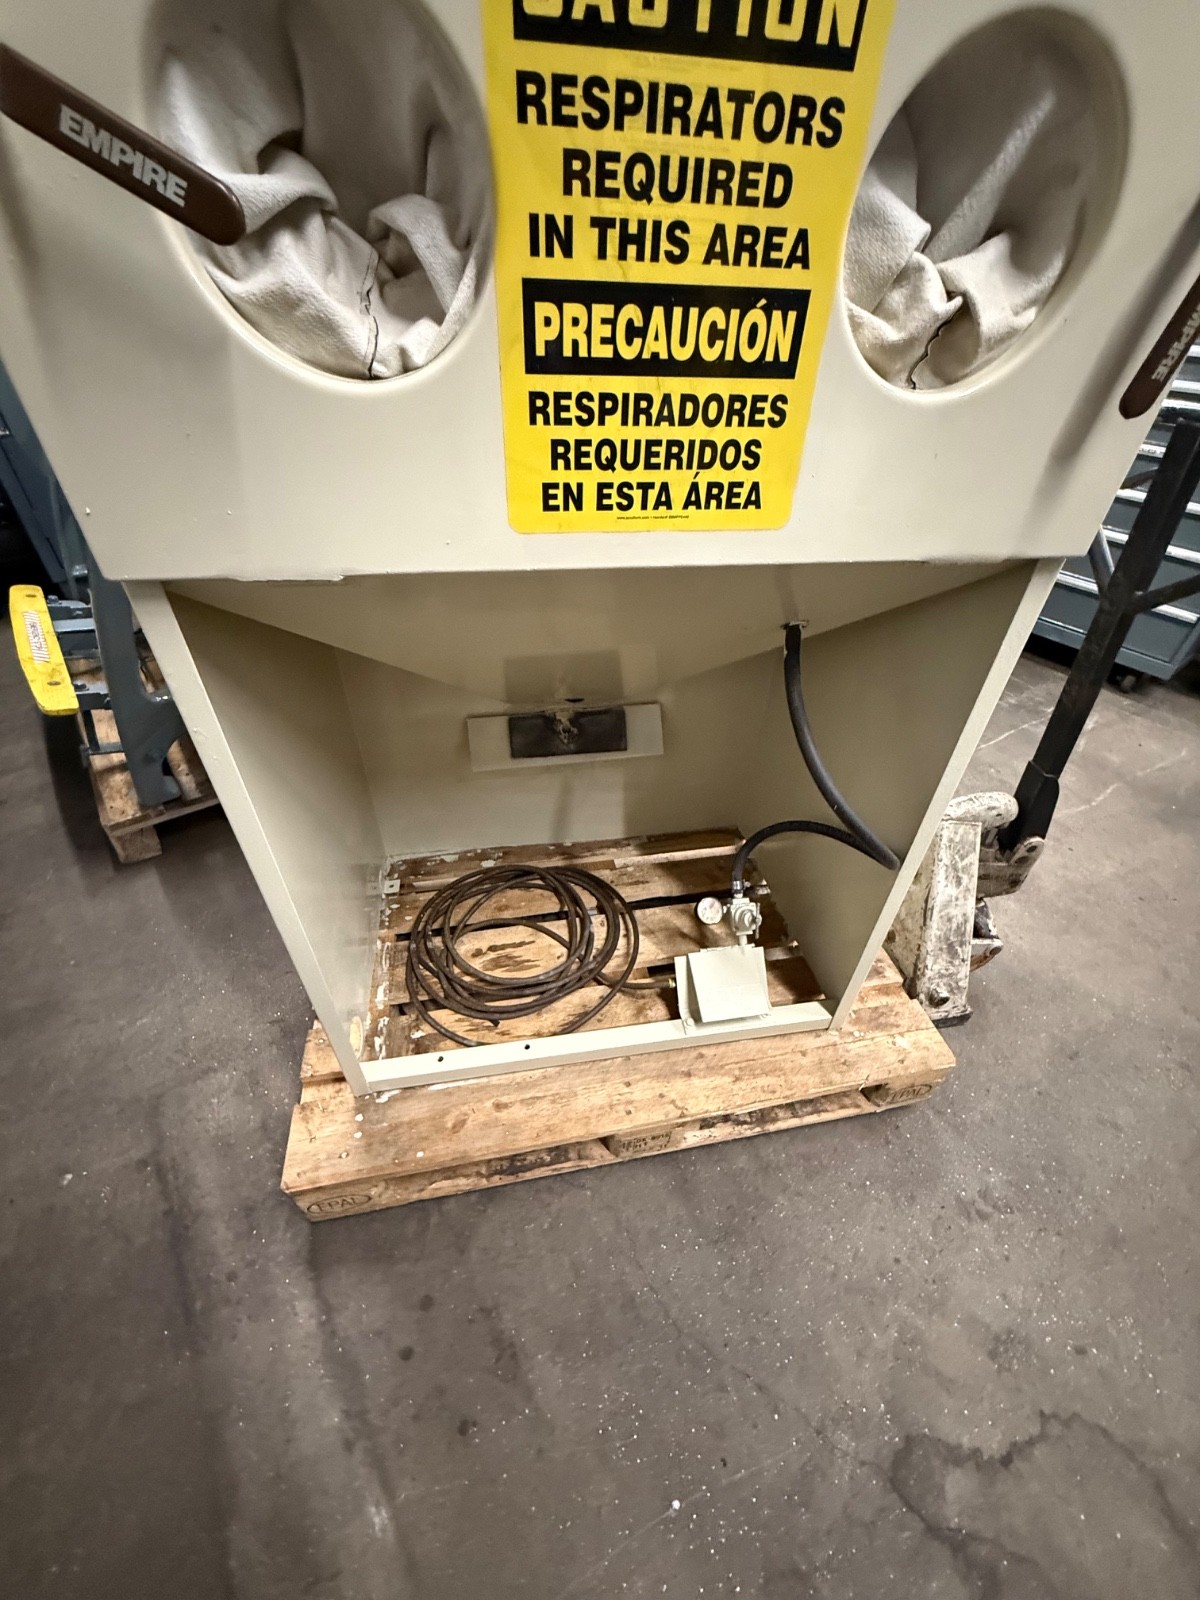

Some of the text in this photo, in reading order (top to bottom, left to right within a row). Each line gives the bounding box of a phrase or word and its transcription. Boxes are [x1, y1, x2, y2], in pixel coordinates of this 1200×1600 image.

[515, 69, 846, 149] RESPIRATORS
[59, 103, 189, 208] EMPIRE
[562, 147, 793, 209] REQUIRED
[528, 212, 811, 270] IN THIS AREA
[534, 298, 799, 363] PRECAUCIÓN
[528, 391, 789, 429] RESPIRADORES
[550, 438, 762, 473] REQUERIDOS
[541, 471, 762, 512] EN ESTA ÁREA
